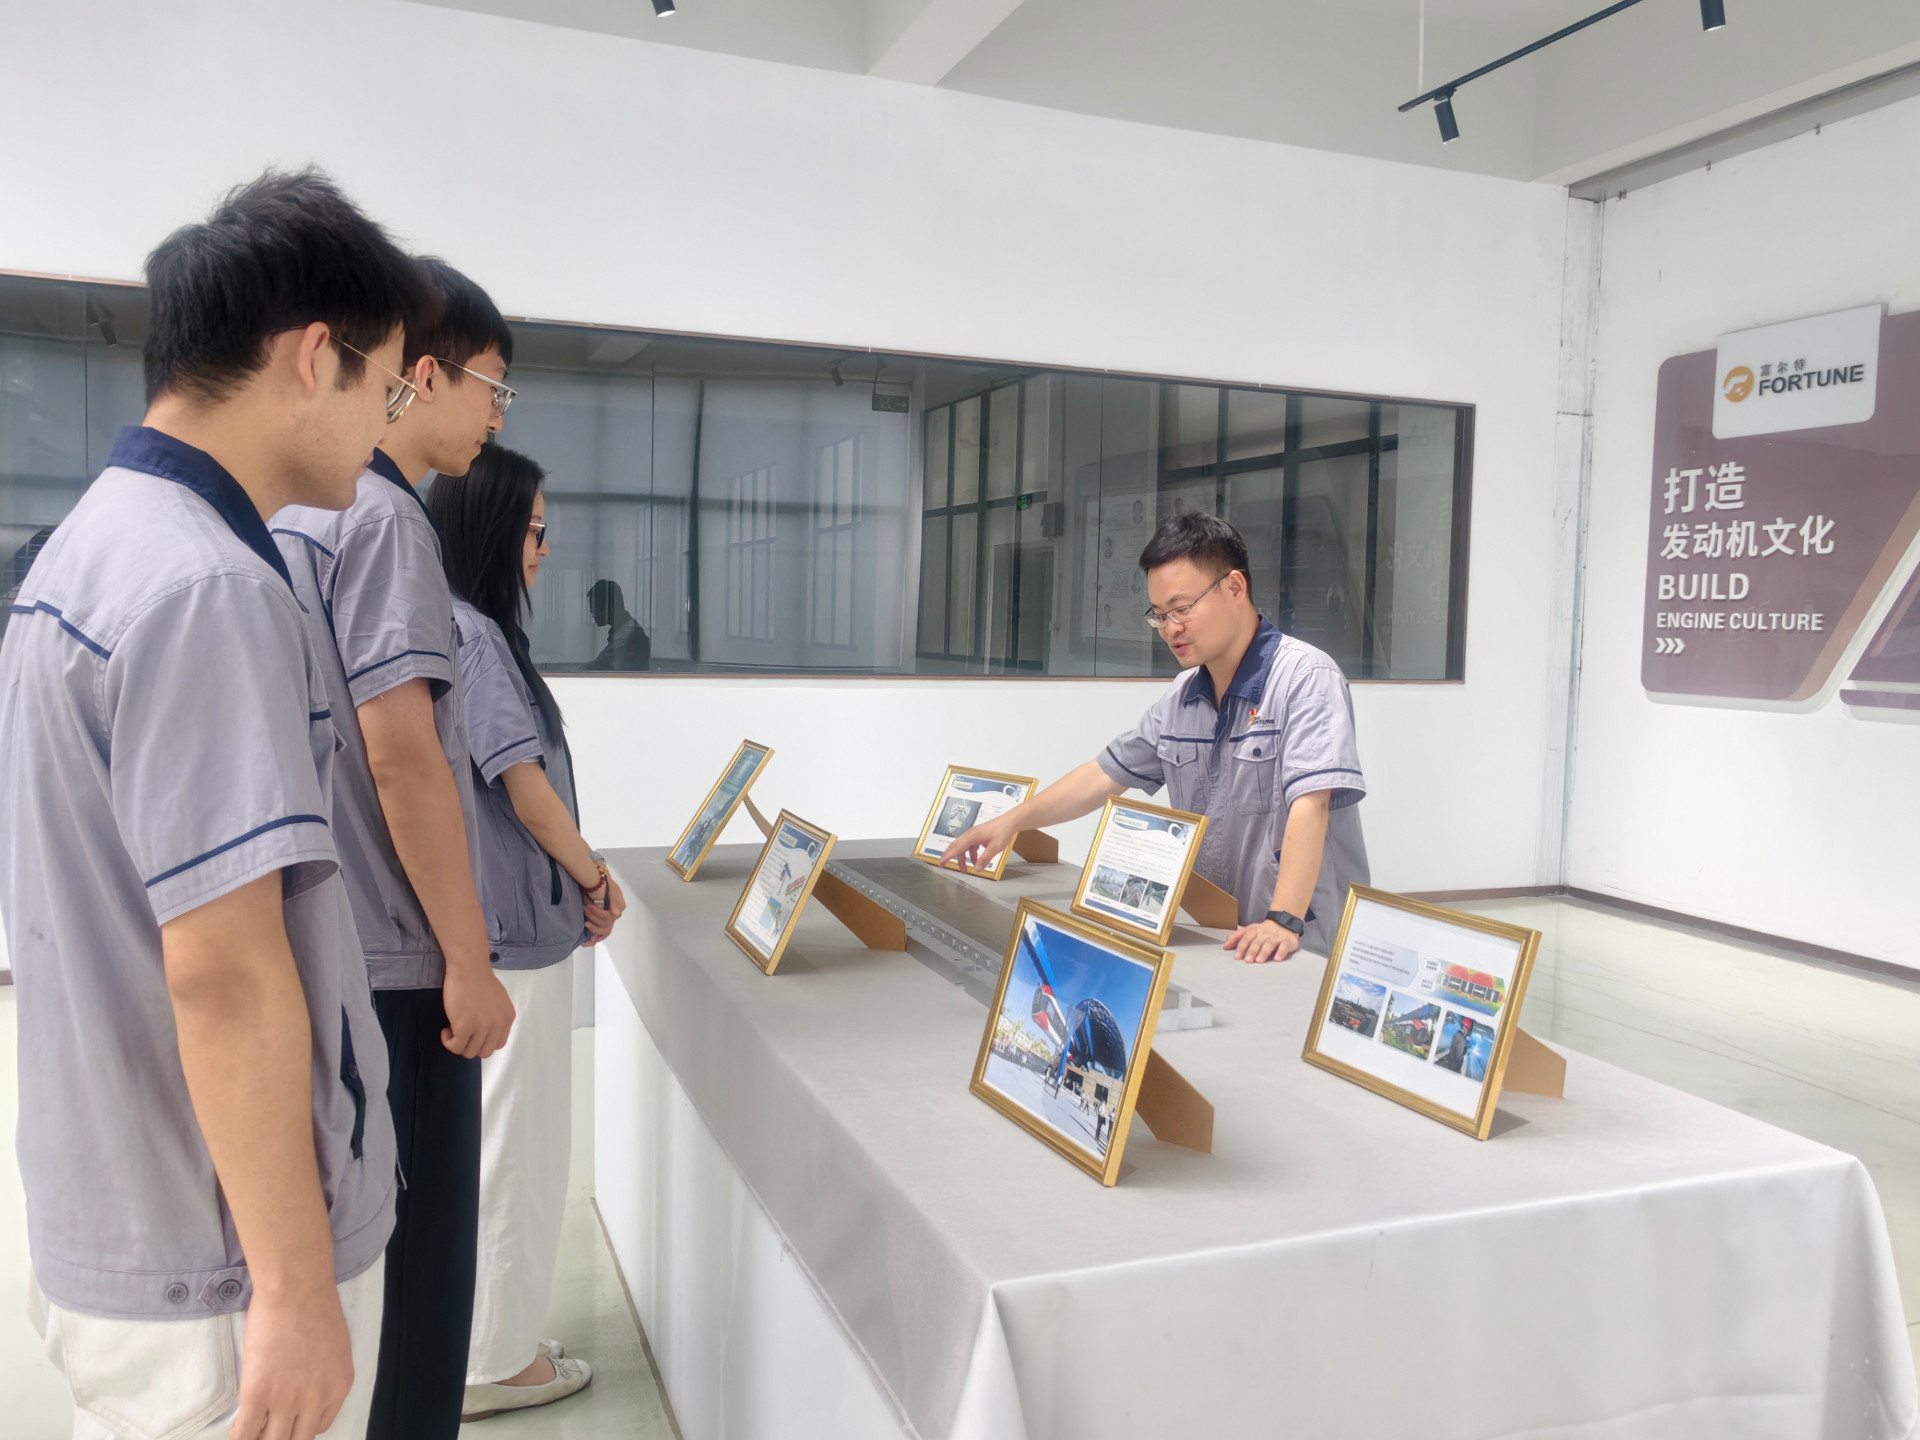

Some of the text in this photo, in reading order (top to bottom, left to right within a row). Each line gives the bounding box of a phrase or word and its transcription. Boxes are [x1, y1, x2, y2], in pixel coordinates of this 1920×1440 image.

[1758, 364, 1864, 396] FORTUNE
[1760, 358, 1806, 377] 富尔特
[1664, 461, 1746, 514] 打造
[1660, 515, 1835, 560] 发动机文化
[1658, 573, 1750, 601] BUILD
[1656, 612, 1824, 631] ENGINE CULTURE
